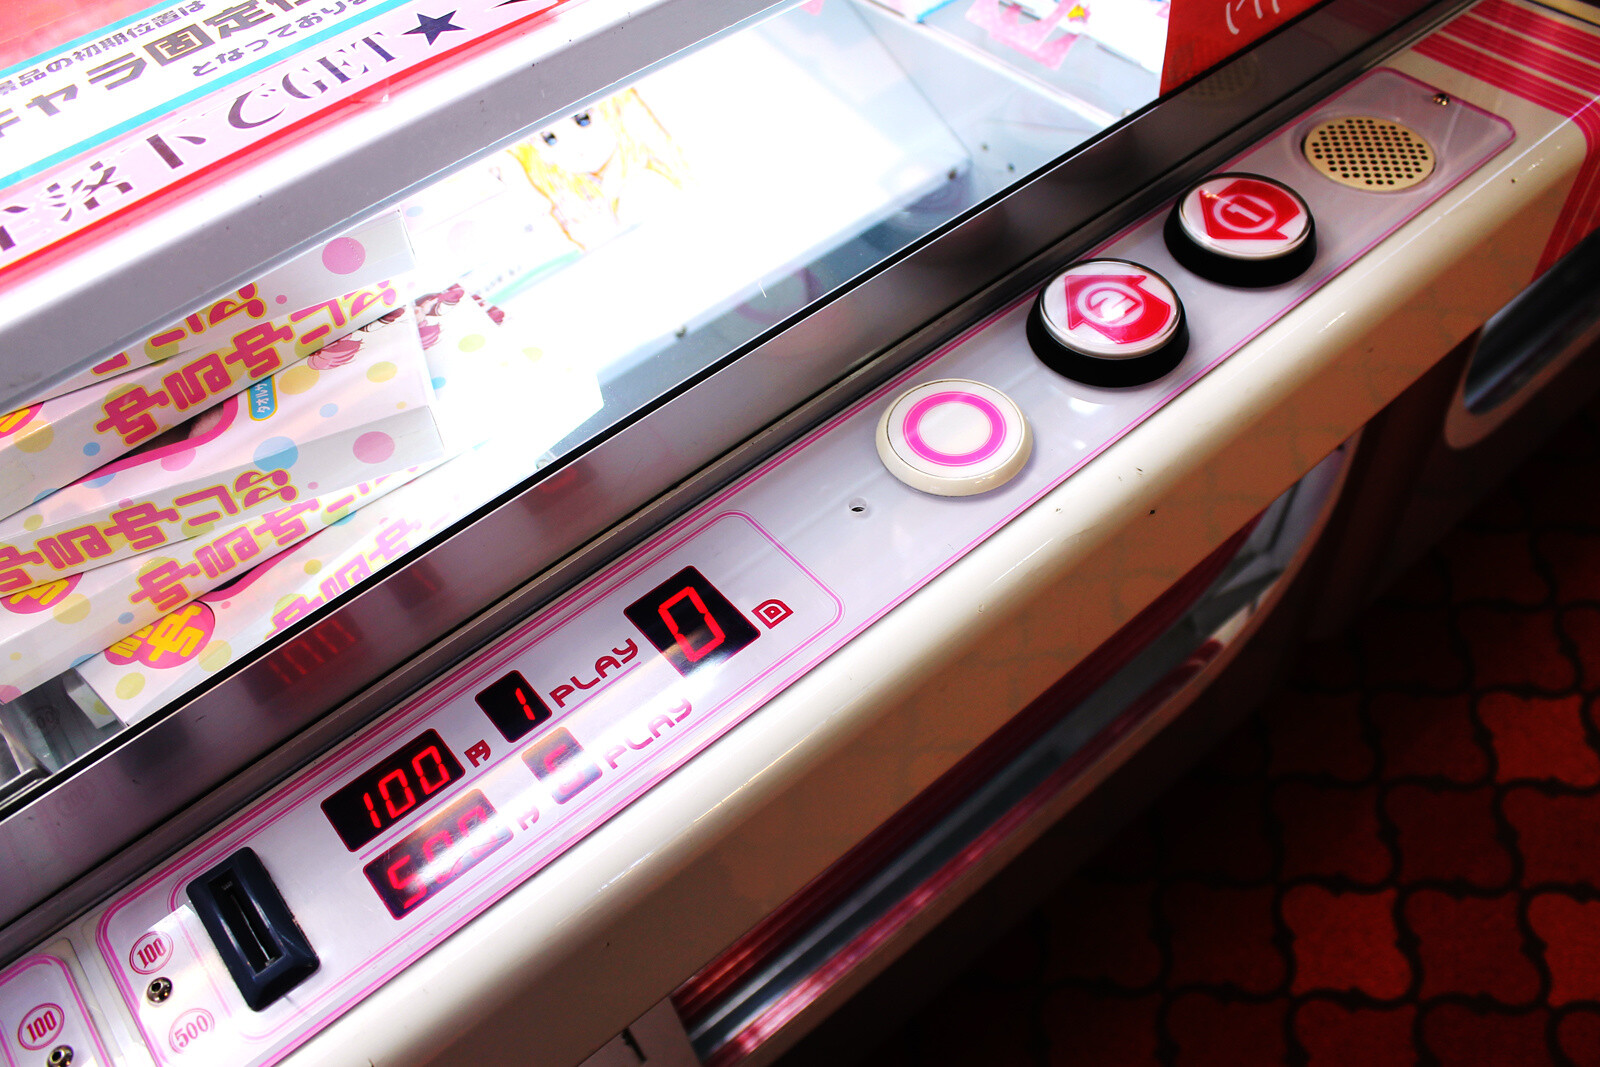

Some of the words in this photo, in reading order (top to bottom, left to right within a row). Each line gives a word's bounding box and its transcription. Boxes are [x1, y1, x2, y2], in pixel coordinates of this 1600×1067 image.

[362, 744, 451, 829] 100
[514, 686, 536, 721] 1
[548, 637, 639, 709] PLAY
[657, 585, 726, 663] 0
[602, 697, 693, 771] PLAY
[136, 936, 167, 969] 100
[26, 1009, 58, 1044] 100
[174, 1014, 209, 1048] 500
